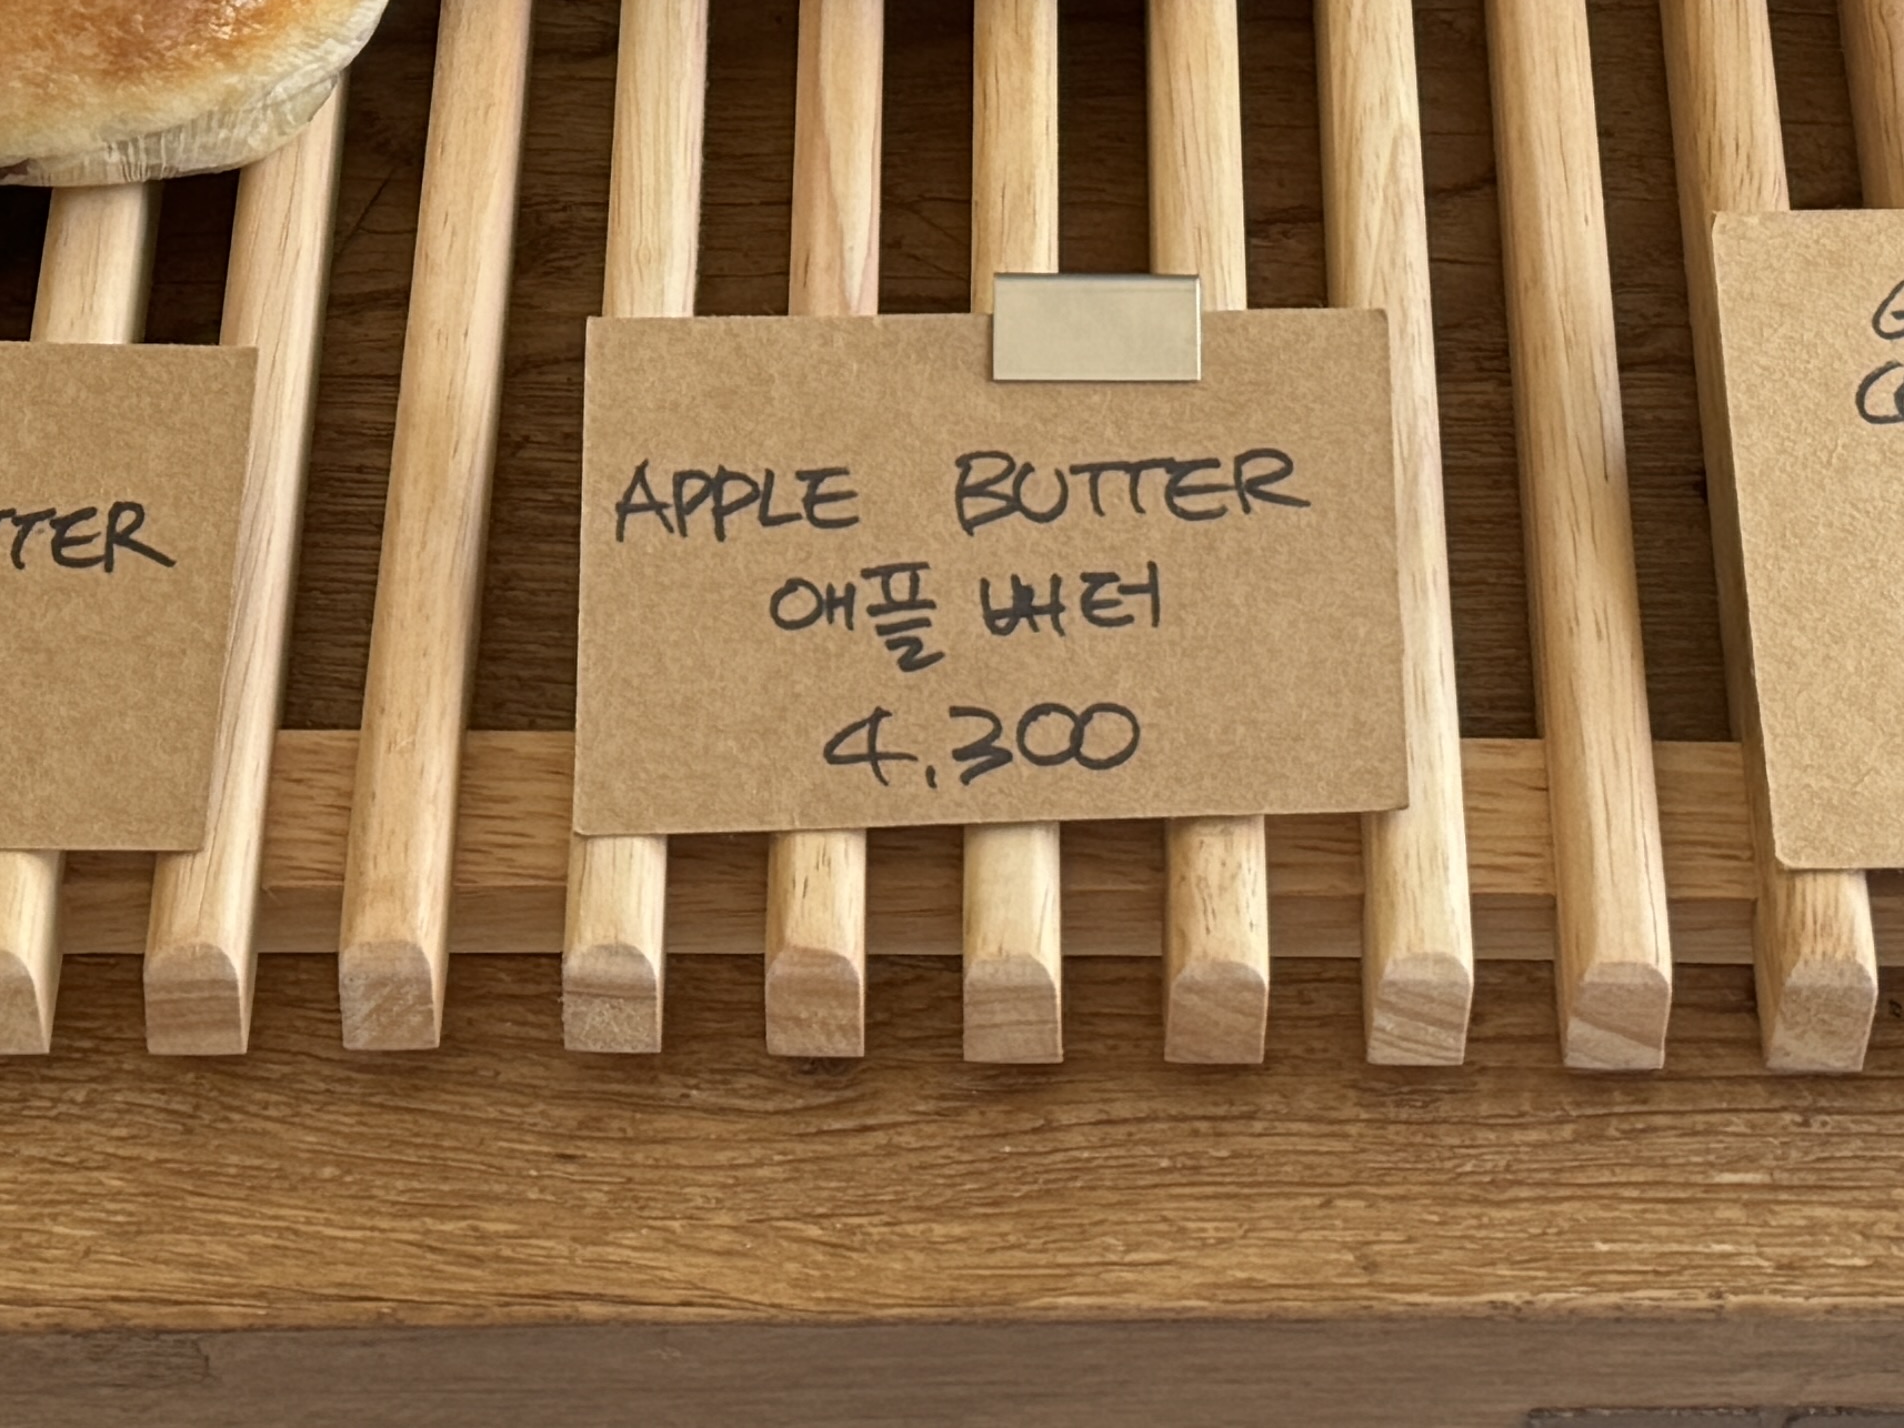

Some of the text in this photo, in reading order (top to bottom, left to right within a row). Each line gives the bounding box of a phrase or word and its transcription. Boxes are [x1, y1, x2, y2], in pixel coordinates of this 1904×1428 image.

[613, 446, 1311, 543] APPLE BUTTER
[767, 559, 1162, 673] 애플 버터
